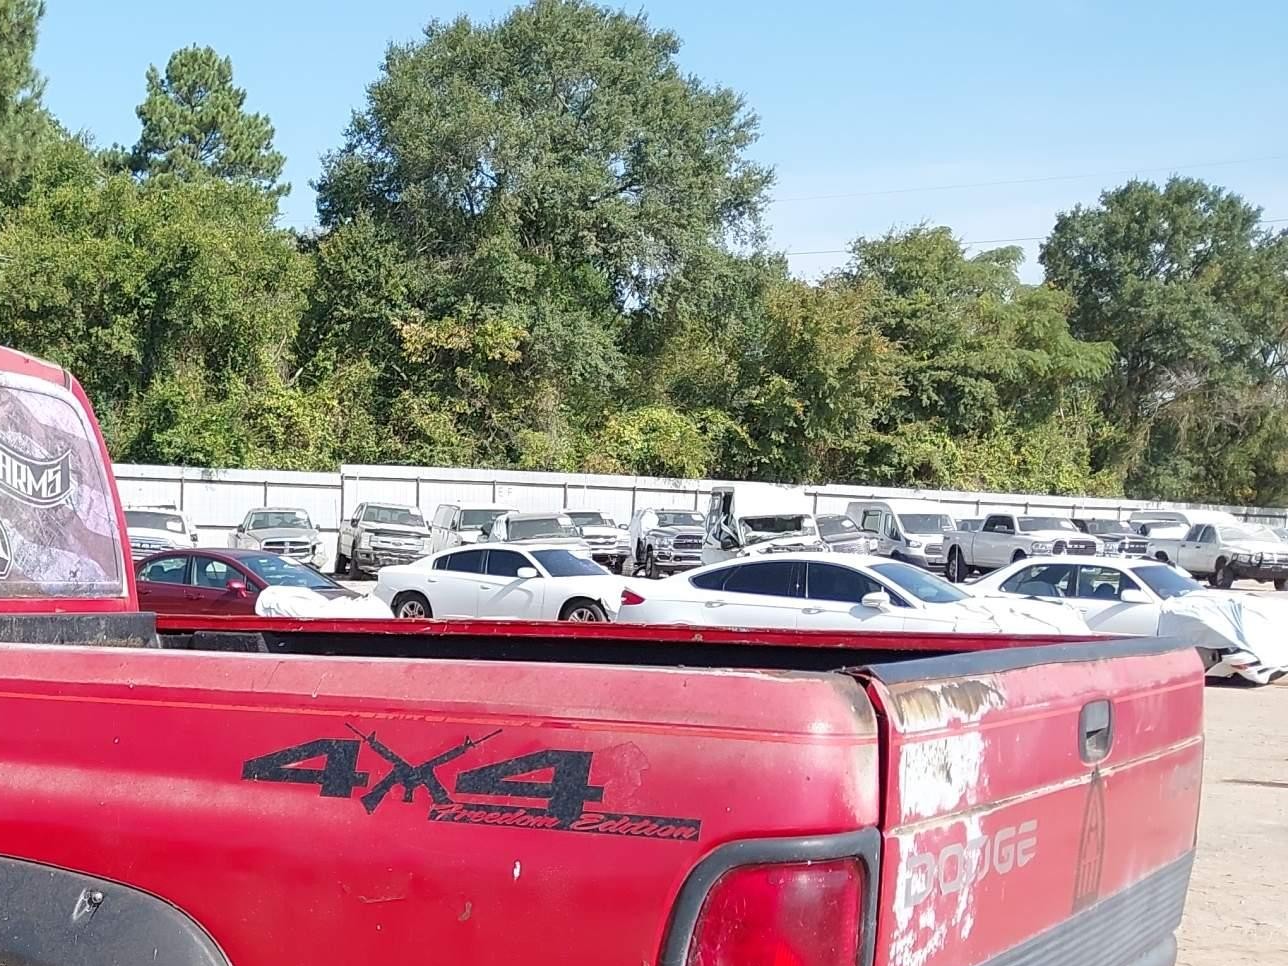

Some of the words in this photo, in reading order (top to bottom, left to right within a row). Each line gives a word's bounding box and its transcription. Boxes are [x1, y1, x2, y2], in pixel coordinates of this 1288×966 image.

[433, 801, 561, 829] Freedom
[569, 812, 699, 839] Edition
[903, 819, 1038, 909] DODGE
